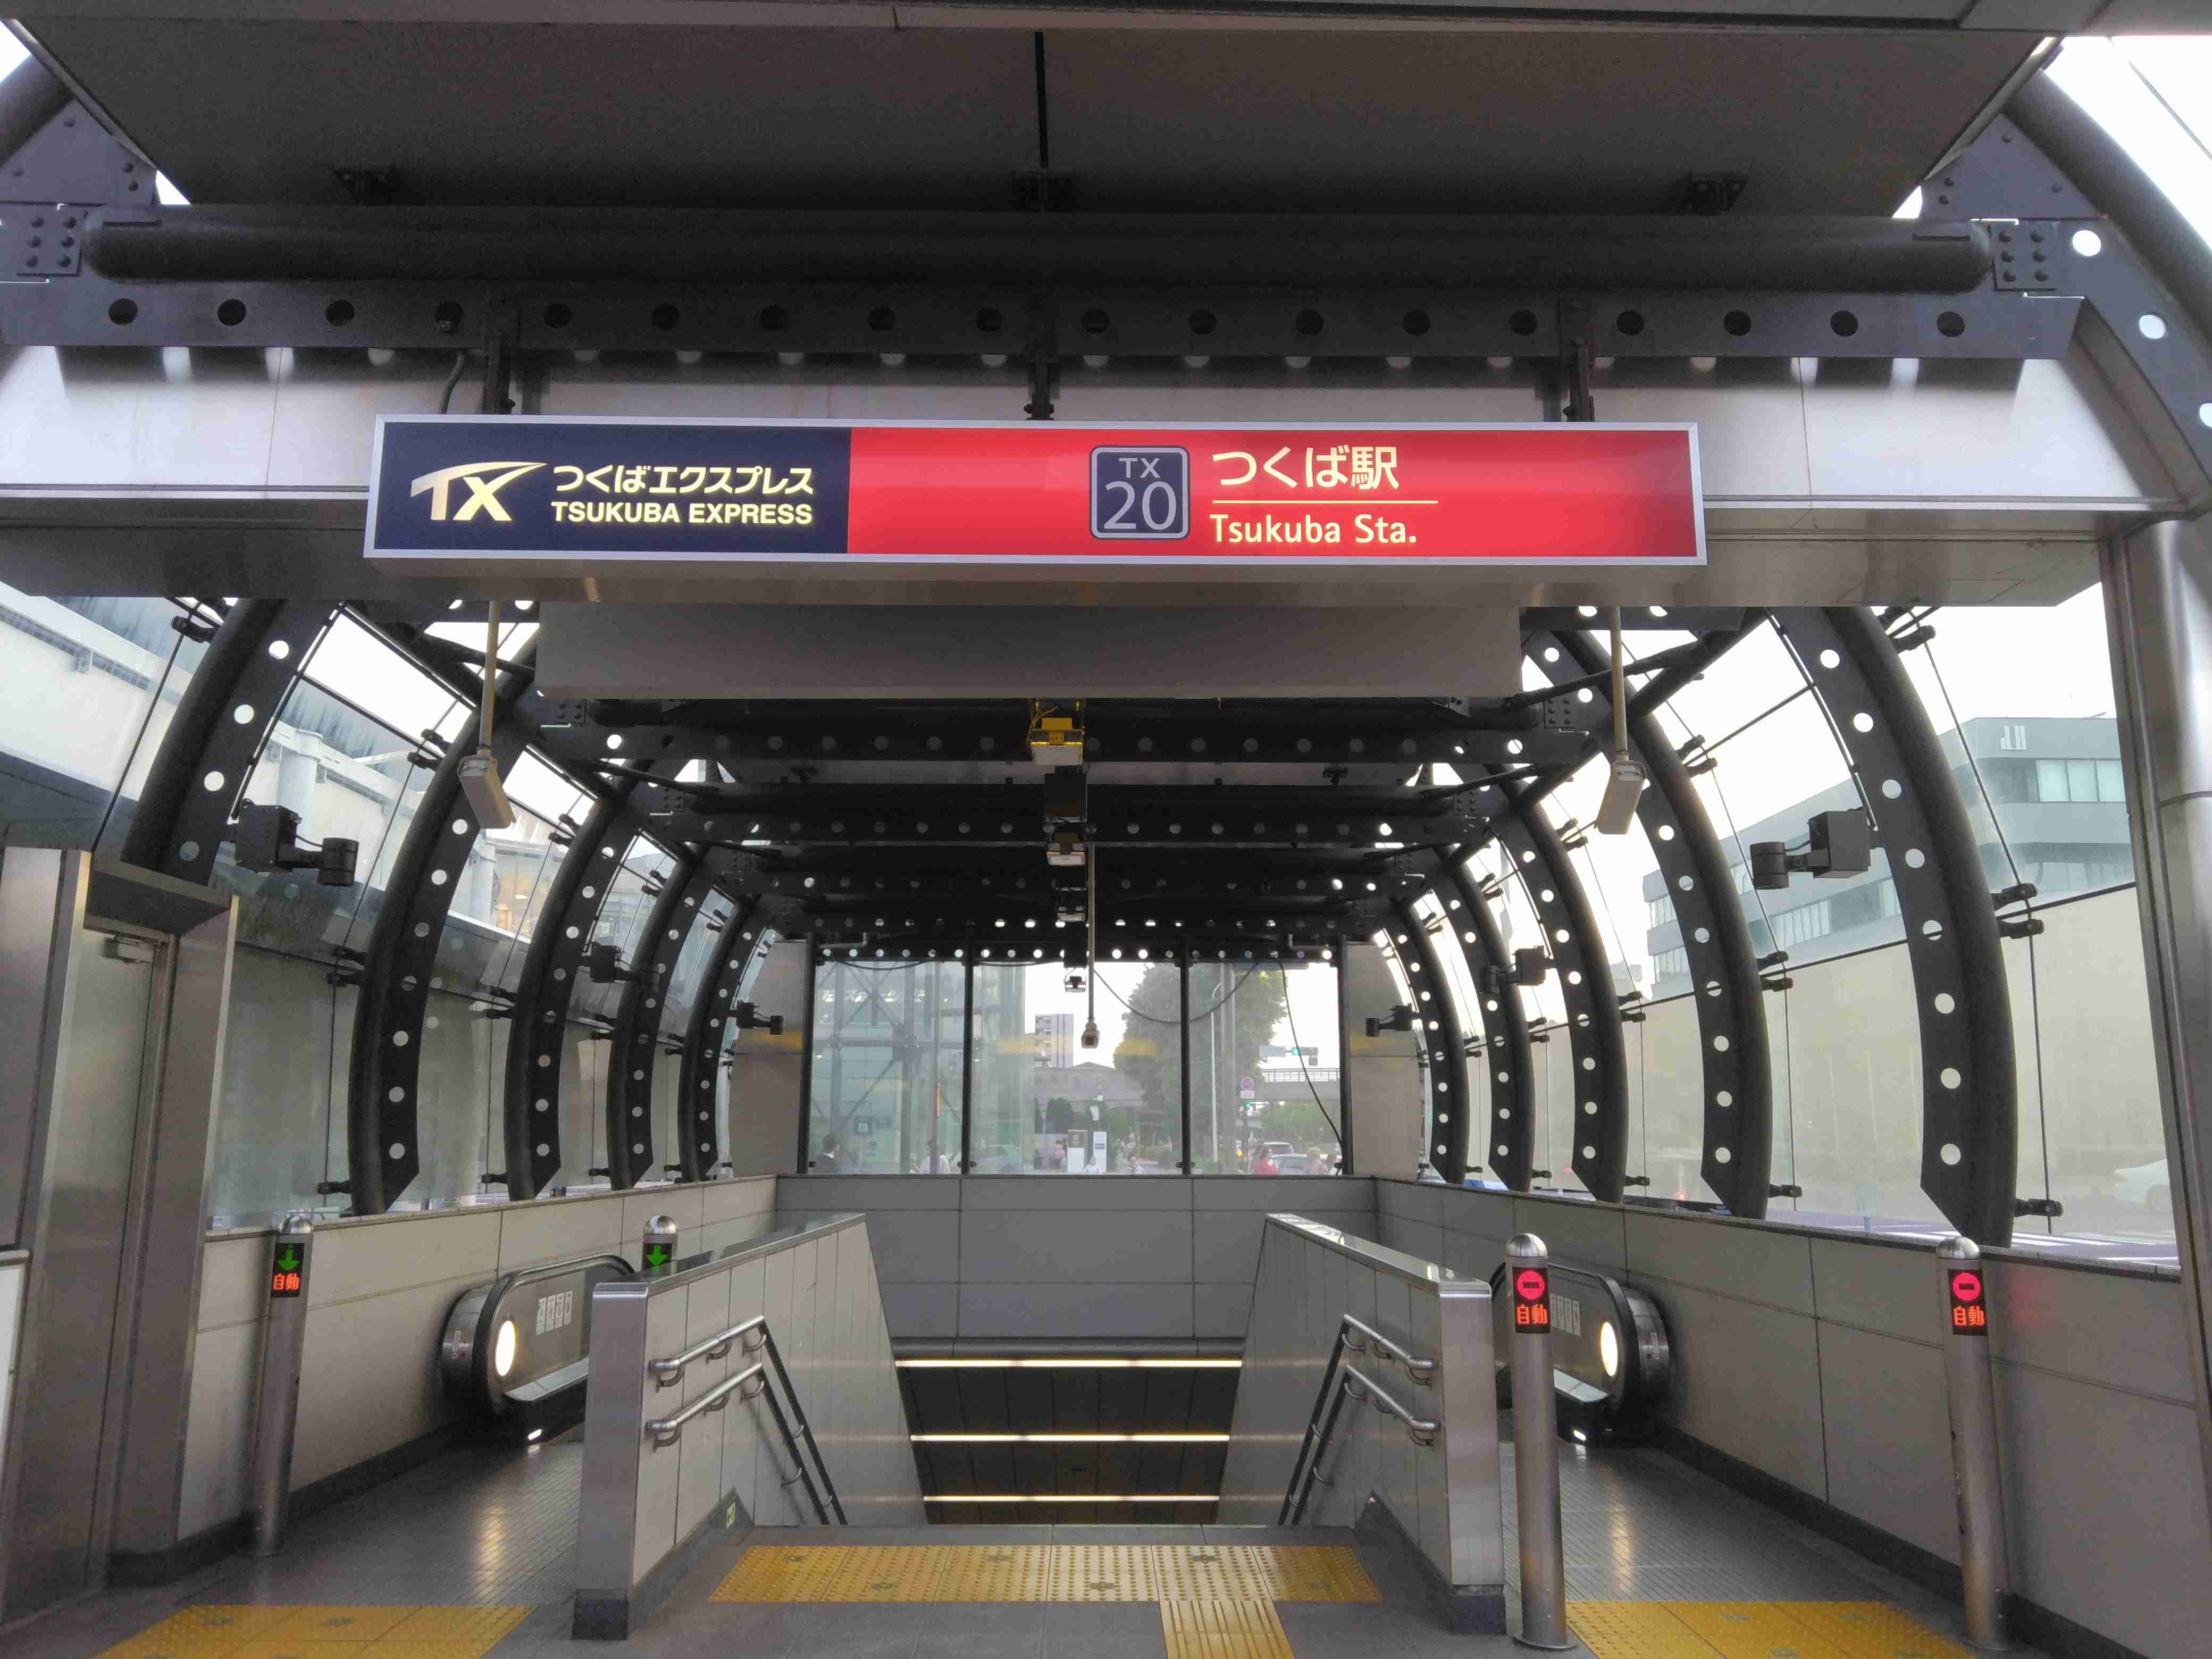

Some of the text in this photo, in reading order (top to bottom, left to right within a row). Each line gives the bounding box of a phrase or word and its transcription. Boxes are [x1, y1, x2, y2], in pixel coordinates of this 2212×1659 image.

[553, 464, 814, 495] つくばエクスプレス
[1118, 457, 1160, 479] TX
[1212, 445, 1400, 490] つくば駅
[411, 462, 548, 521] TX
[551, 501, 812, 525] TSUKUBA EXPRESS
[1104, 481, 1177, 530] 20
[1209, 514, 1417, 543] Tsukuba Sta.
[273, 1272, 300, 1291] 自動
[1516, 1303, 1548, 1325] 自動
[1953, 1305, 1985, 1326] 自動
